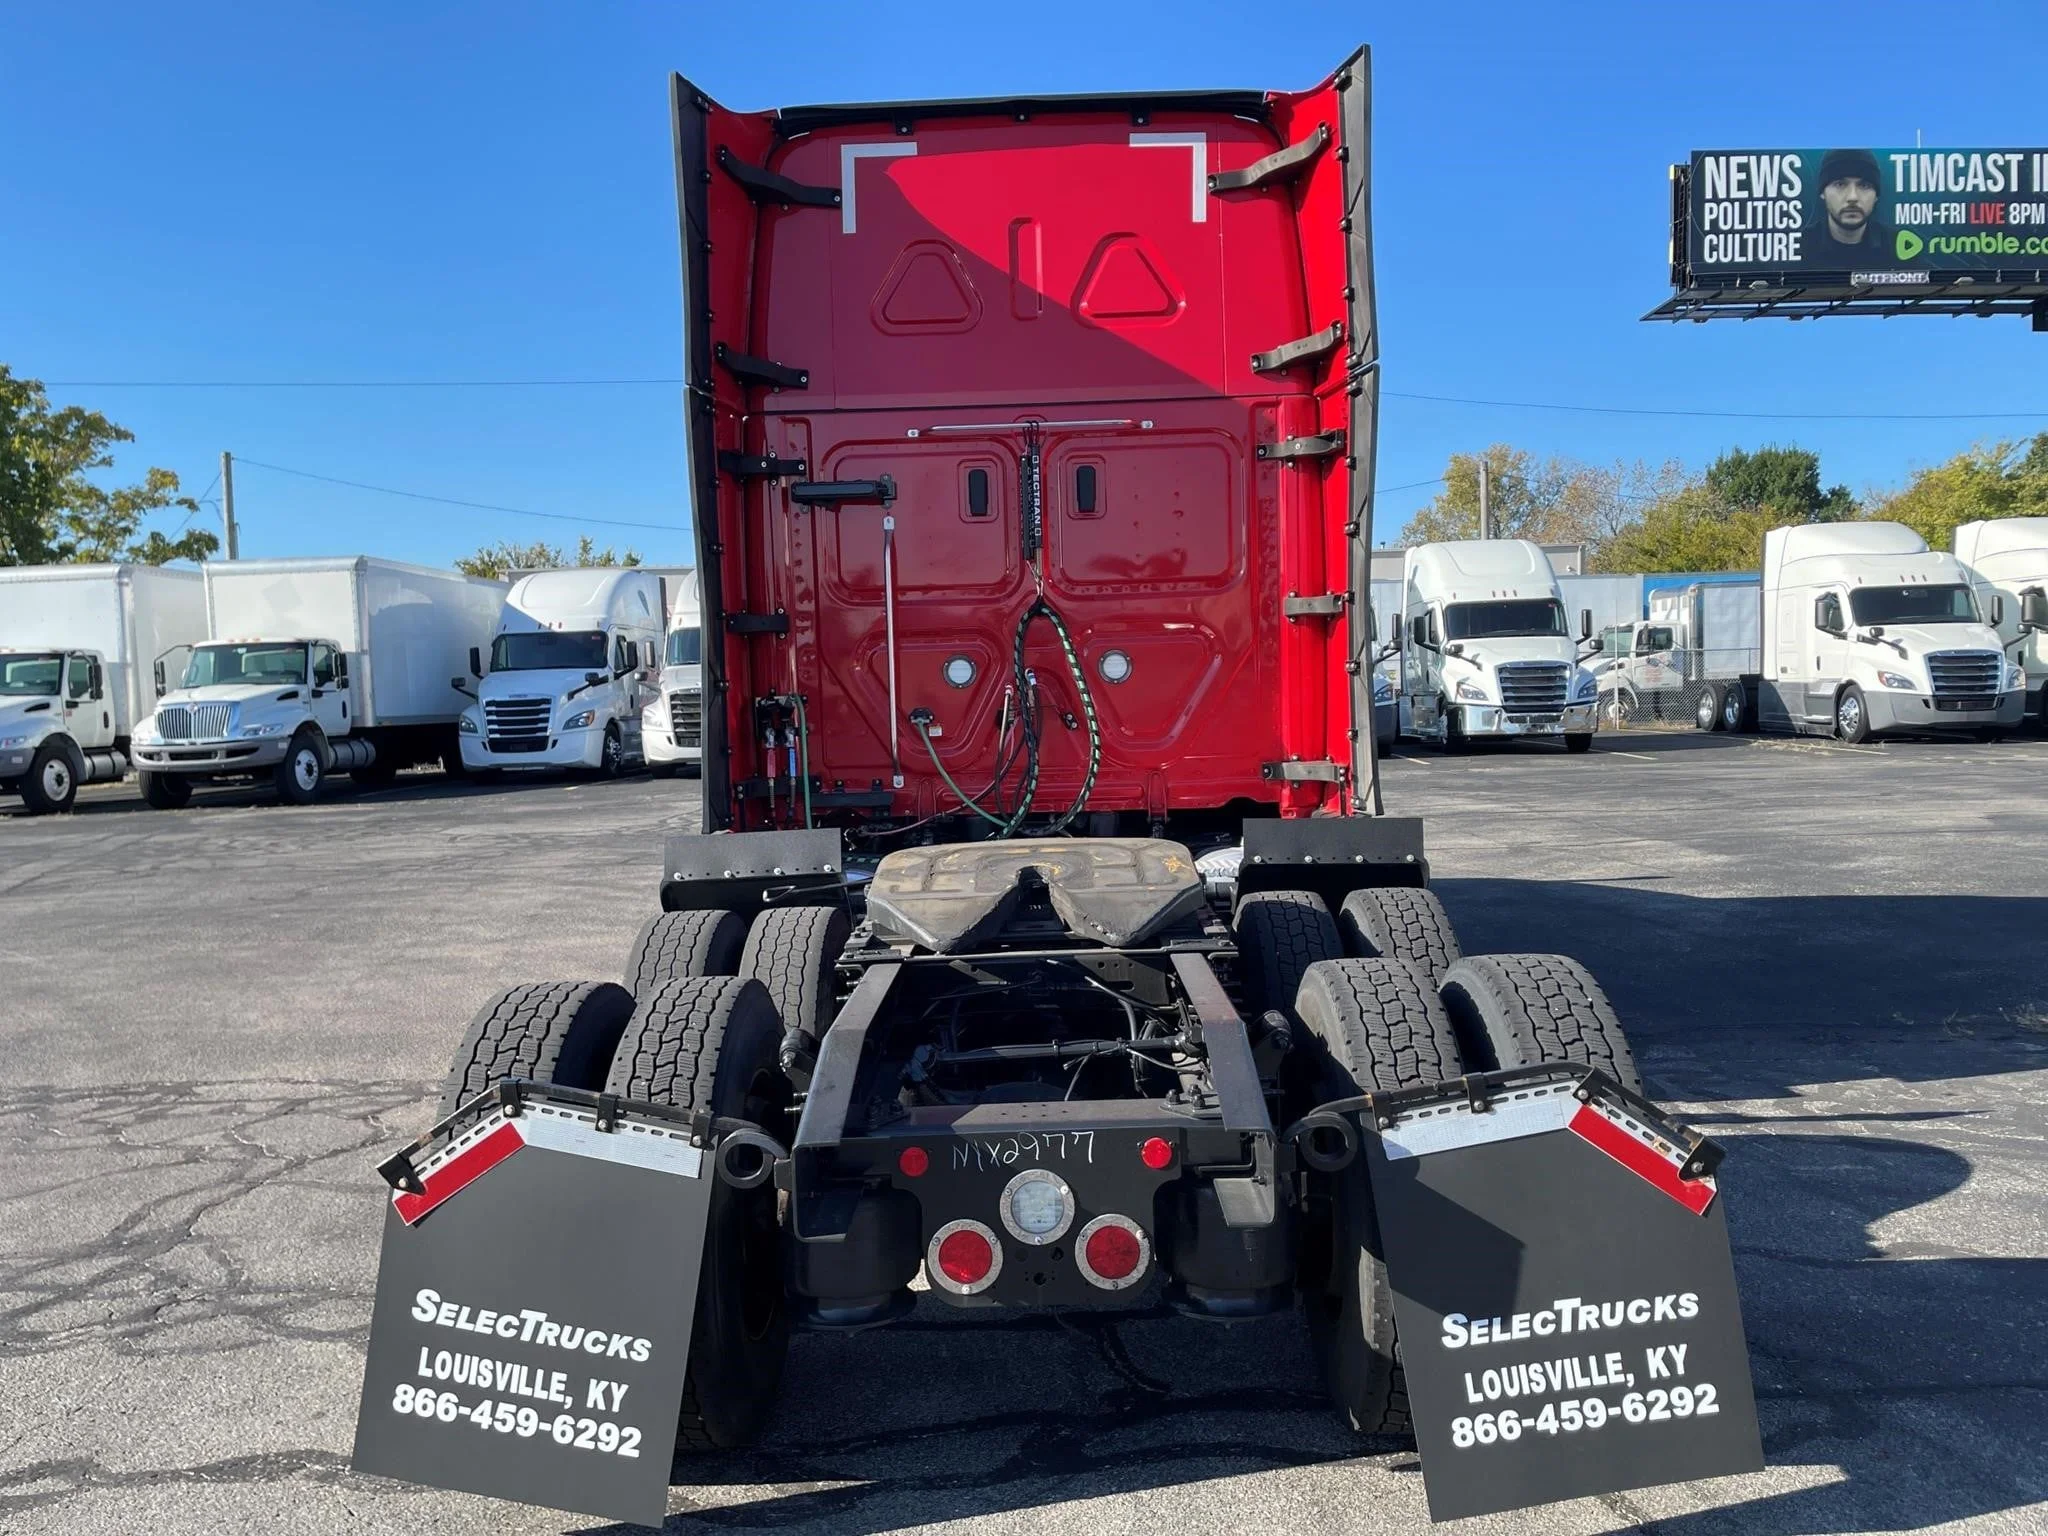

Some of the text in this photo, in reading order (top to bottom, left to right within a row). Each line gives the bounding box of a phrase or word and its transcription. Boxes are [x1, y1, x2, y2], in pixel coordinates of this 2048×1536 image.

[1704, 154, 1802, 200] NEWS
[1890, 153, 2024, 193] TIMCAST
[1704, 200, 1802, 231] POLITICS
[1895, 202, 2046, 225] MON-FRI LIVE 8PM
[1704, 232, 1802, 264] CULTURE
[1032, 467, 1041, 524] TECTRAN
[417, 1346, 629, 1413] LOUISVILLE, KY
[1464, 1343, 1688, 1404] LOUISVILLE, KY
[392, 1383, 642, 1458] 866-459-6292
[1451, 1383, 1720, 1448] 866-459-6292
